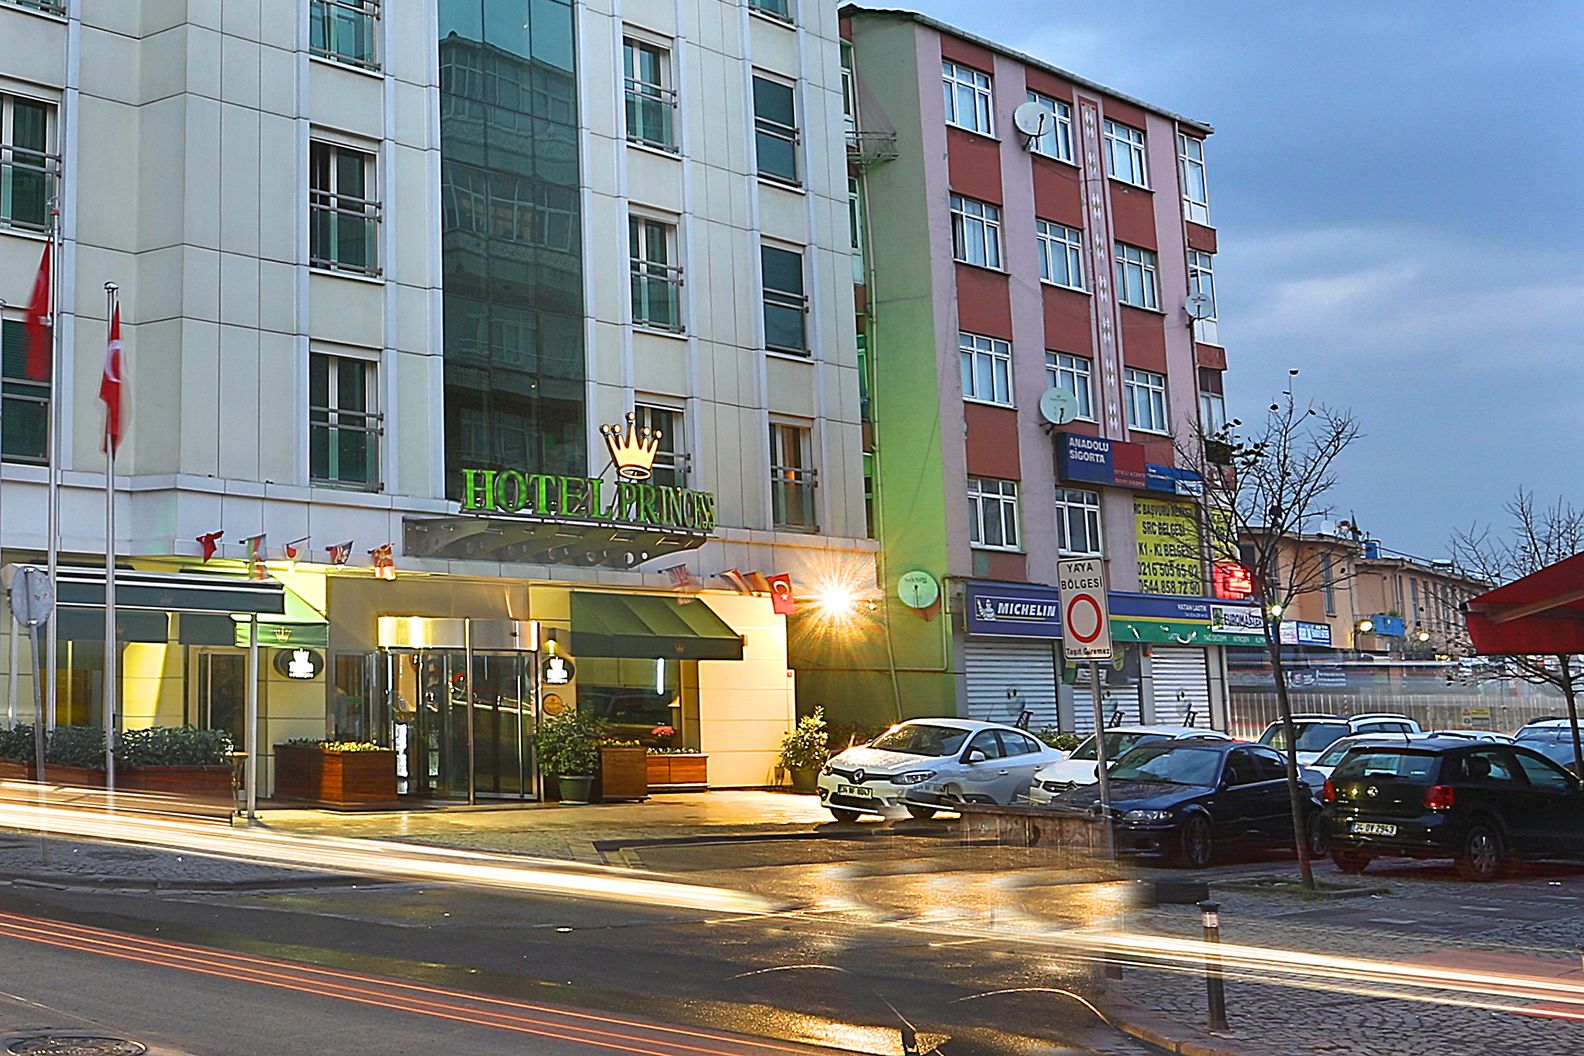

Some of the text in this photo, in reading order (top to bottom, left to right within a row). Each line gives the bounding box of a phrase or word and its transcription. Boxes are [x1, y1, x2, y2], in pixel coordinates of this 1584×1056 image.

[1068, 437, 1109, 452] ANADOLU
[1069, 447, 1106, 464] SİGORTA
[461, 468, 717, 530] HOTEL PRINCESS
[1067, 562, 1094, 573] YAYA
[1061, 575, 1103, 590] BÖLGESİ
[997, 602, 1057, 617] MICHELIN
